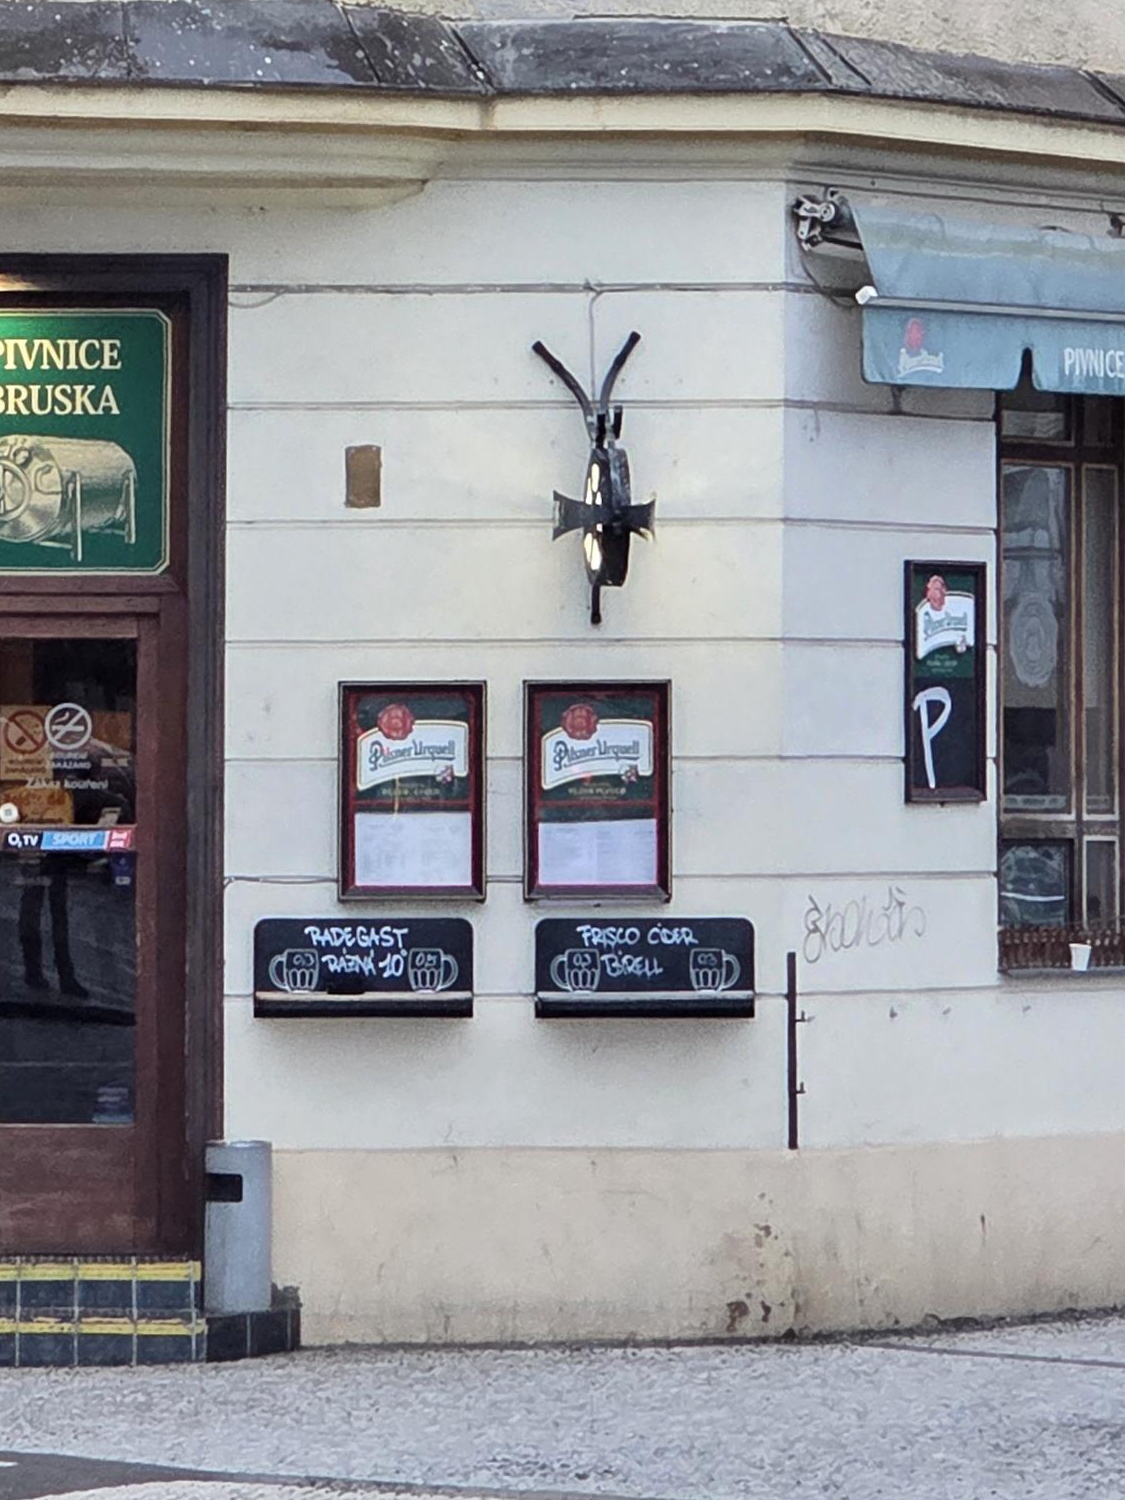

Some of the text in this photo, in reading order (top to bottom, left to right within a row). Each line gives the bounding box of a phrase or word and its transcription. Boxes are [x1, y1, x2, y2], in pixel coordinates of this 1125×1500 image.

[1063, 347, 1125, 378] PIVNICE
[912, 686, 952, 790] P
[368, 739, 455, 771] Pilsner Urquell
[553, 739, 640, 771] Pilsner Urquell
[304, 926, 409, 949] RADEGAST
[576, 924, 641, 948] FRISCO
